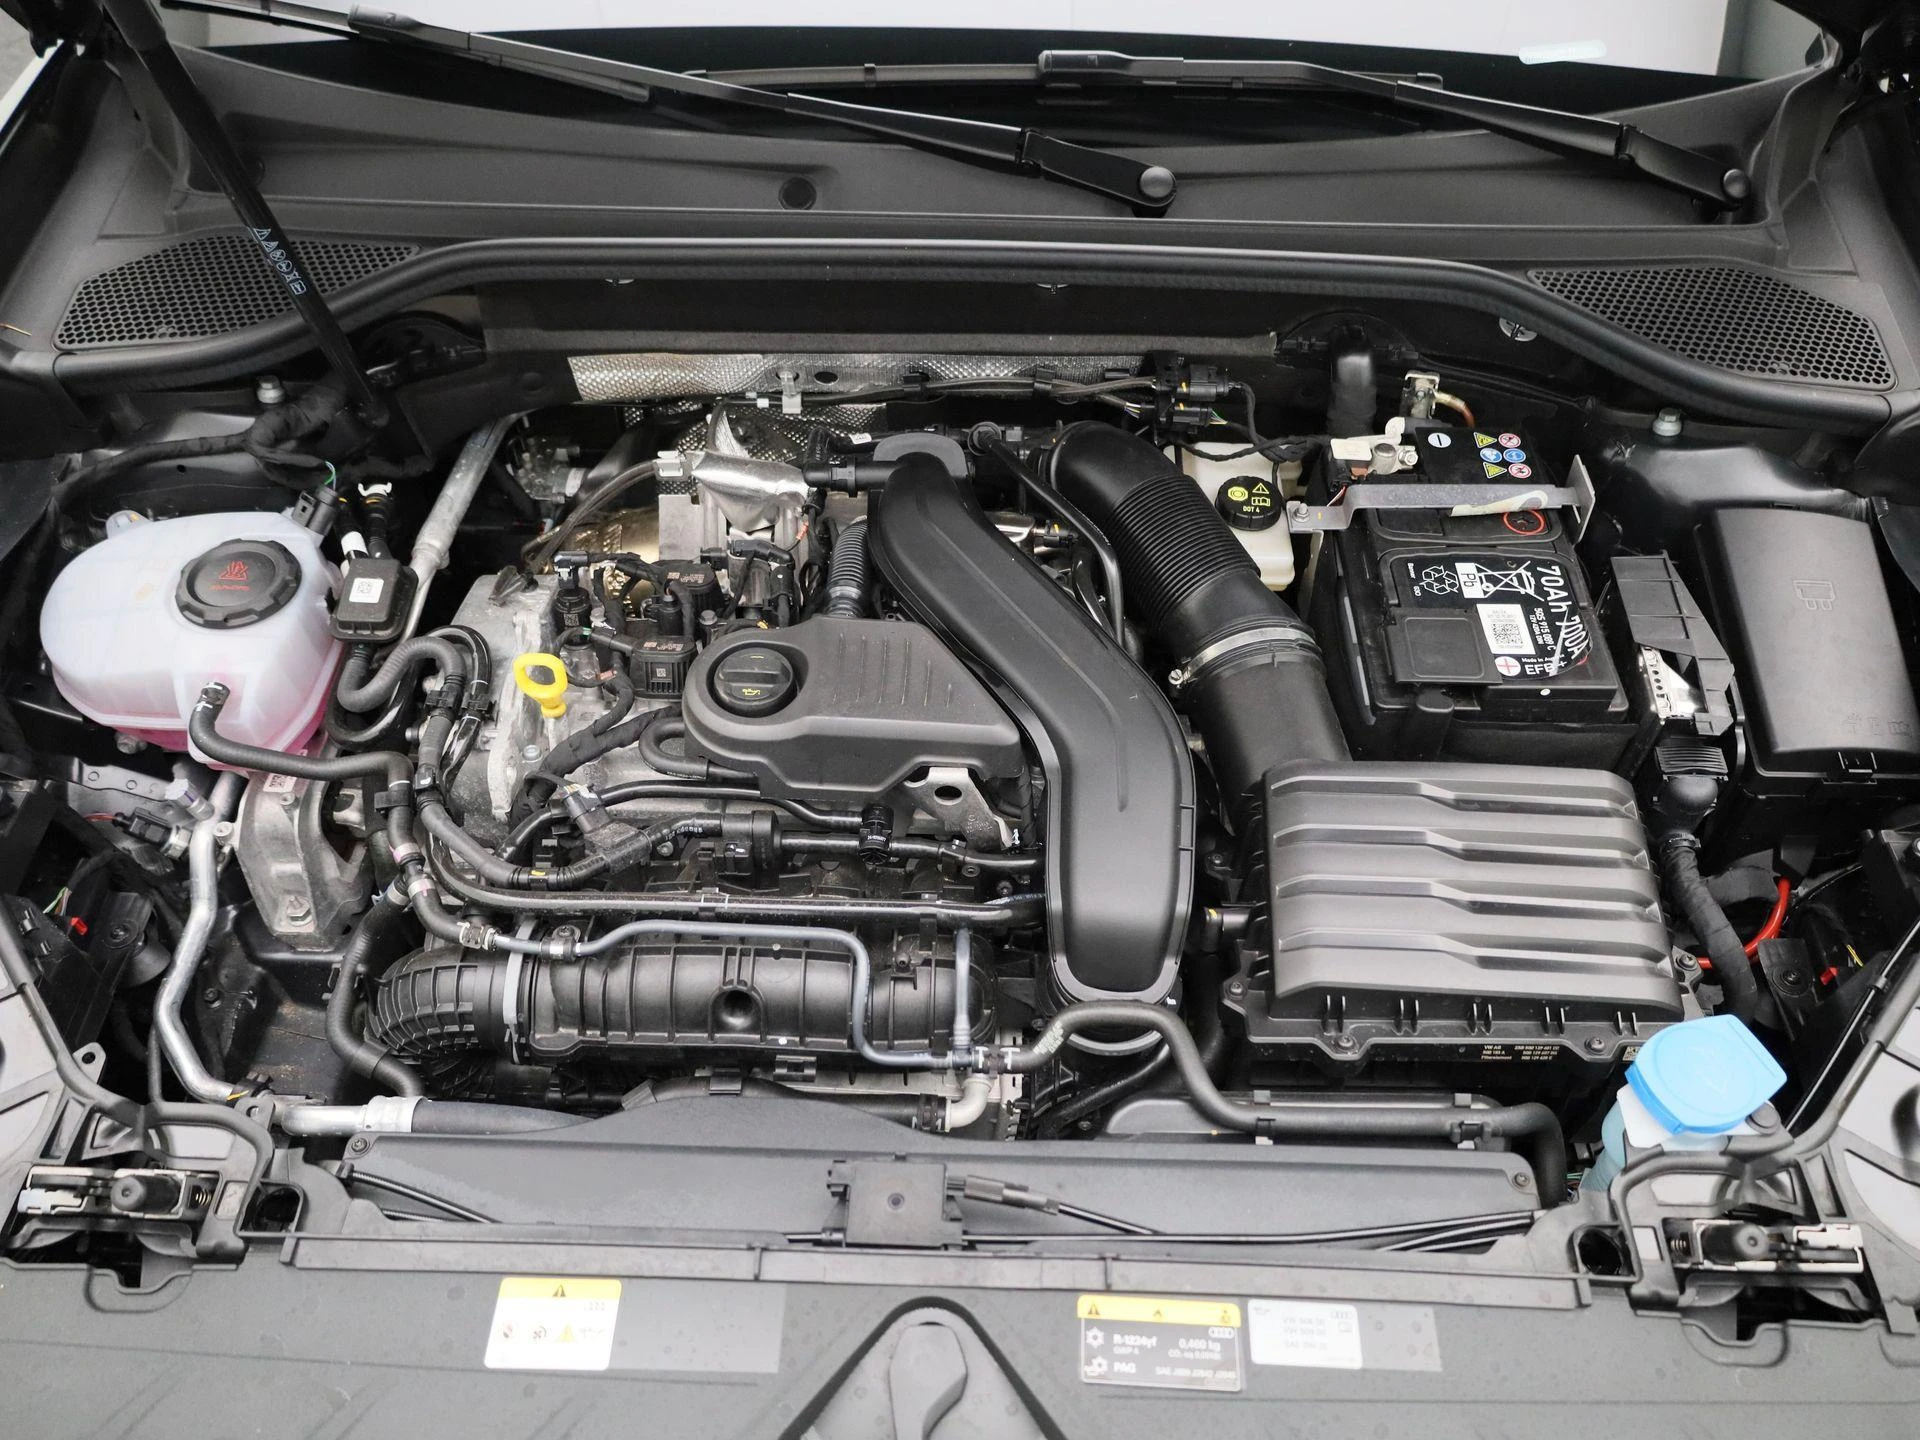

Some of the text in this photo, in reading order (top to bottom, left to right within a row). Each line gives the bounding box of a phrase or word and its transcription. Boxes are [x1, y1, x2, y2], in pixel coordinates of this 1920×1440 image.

[1243, 505, 1254, 513] DOT
[1461, 573, 1478, 587] Pb
[1537, 565, 1572, 613] 70Ah
[1555, 615, 1590, 660] 700A
[1538, 621, 1551, 634] 915
[1208, 1340, 1221, 1352] kg
[1113, 1361, 1137, 1374] PAG
